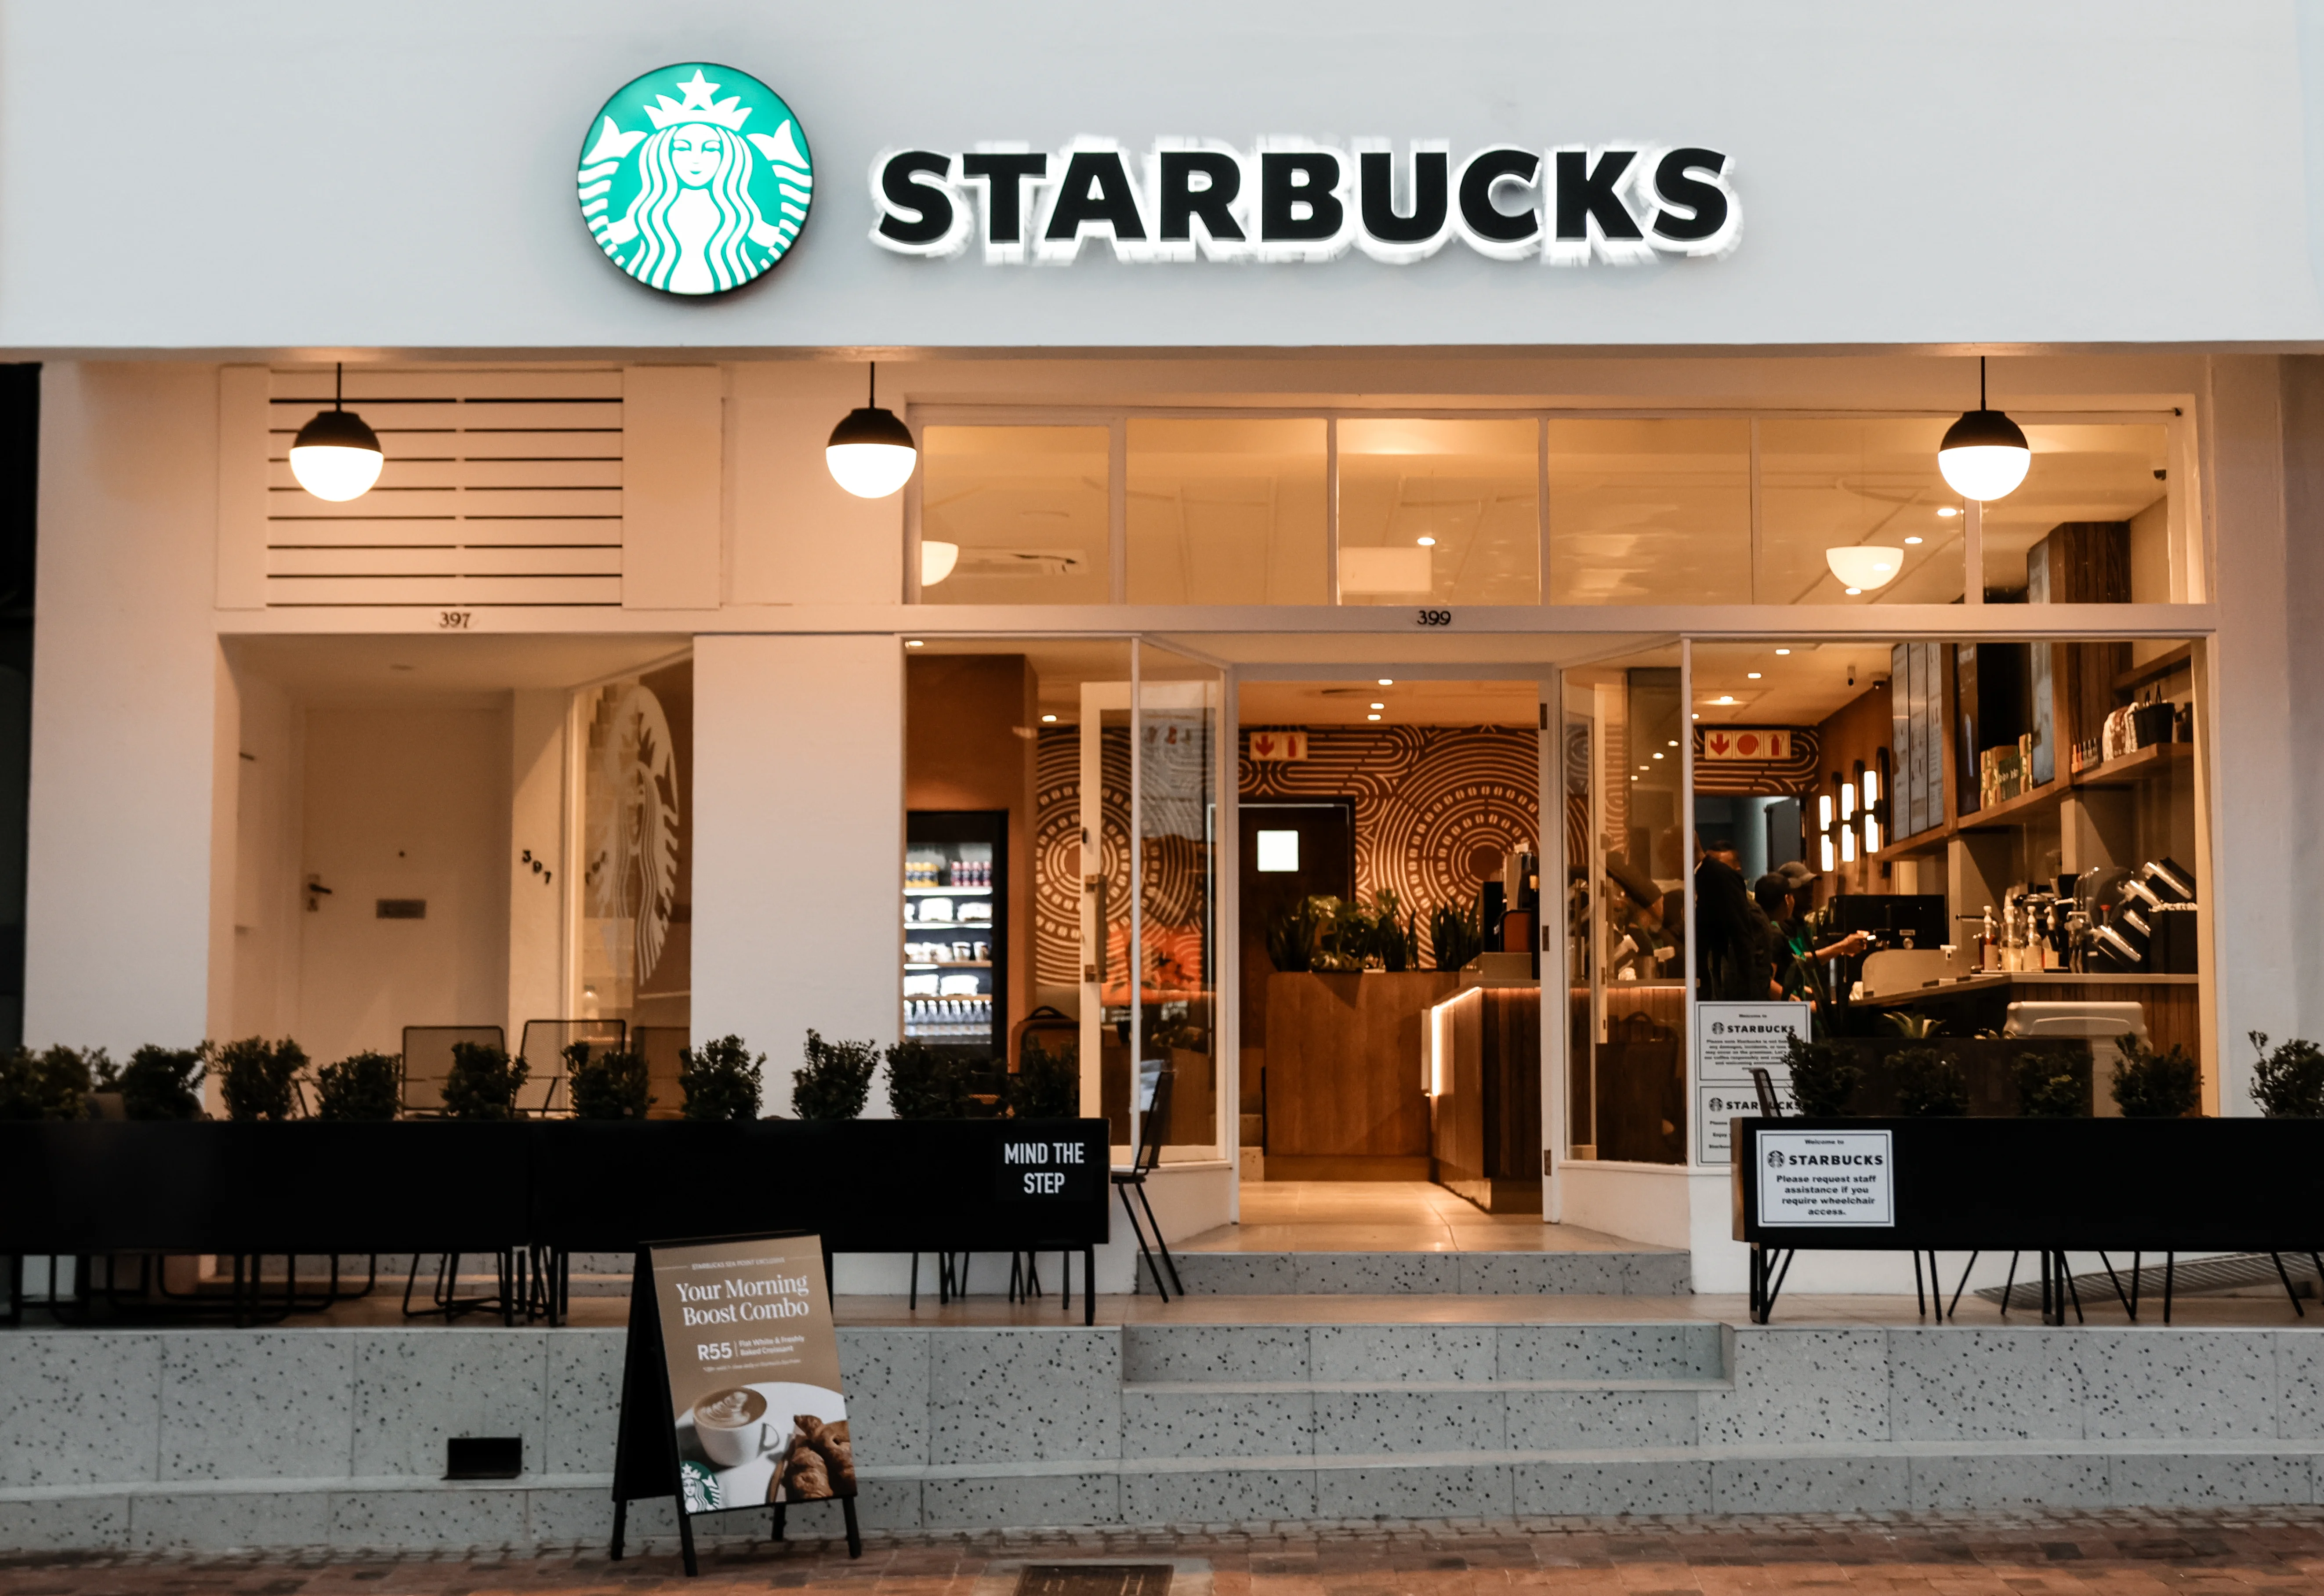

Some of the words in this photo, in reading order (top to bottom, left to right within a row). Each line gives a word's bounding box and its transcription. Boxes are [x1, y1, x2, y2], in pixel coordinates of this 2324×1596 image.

[879, 148, 1728, 244] STARBUCKS
[440, 612, 471, 628] 397
[1417, 610, 1451, 626] 399
[522, 850, 551, 885] 397
[1727, 1025, 1795, 1033] STARBUCKS
[1004, 1143, 1048, 1164] MIND
[1052, 1142, 1085, 1164] THE
[1789, 1154, 1883, 1165] STARBUCKS
[1023, 1172, 1065, 1194] STEP
[1812, 1175, 1850, 1184] request
[1781, 1197, 1817, 1206] require
[676, 1283, 722, 1303] Your
[724, 1274, 809, 1299] Morning
[682, 1304, 738, 1326] Boost
[739, 1297, 809, 1321] Combo
[697, 1342, 733, 1361] R55
